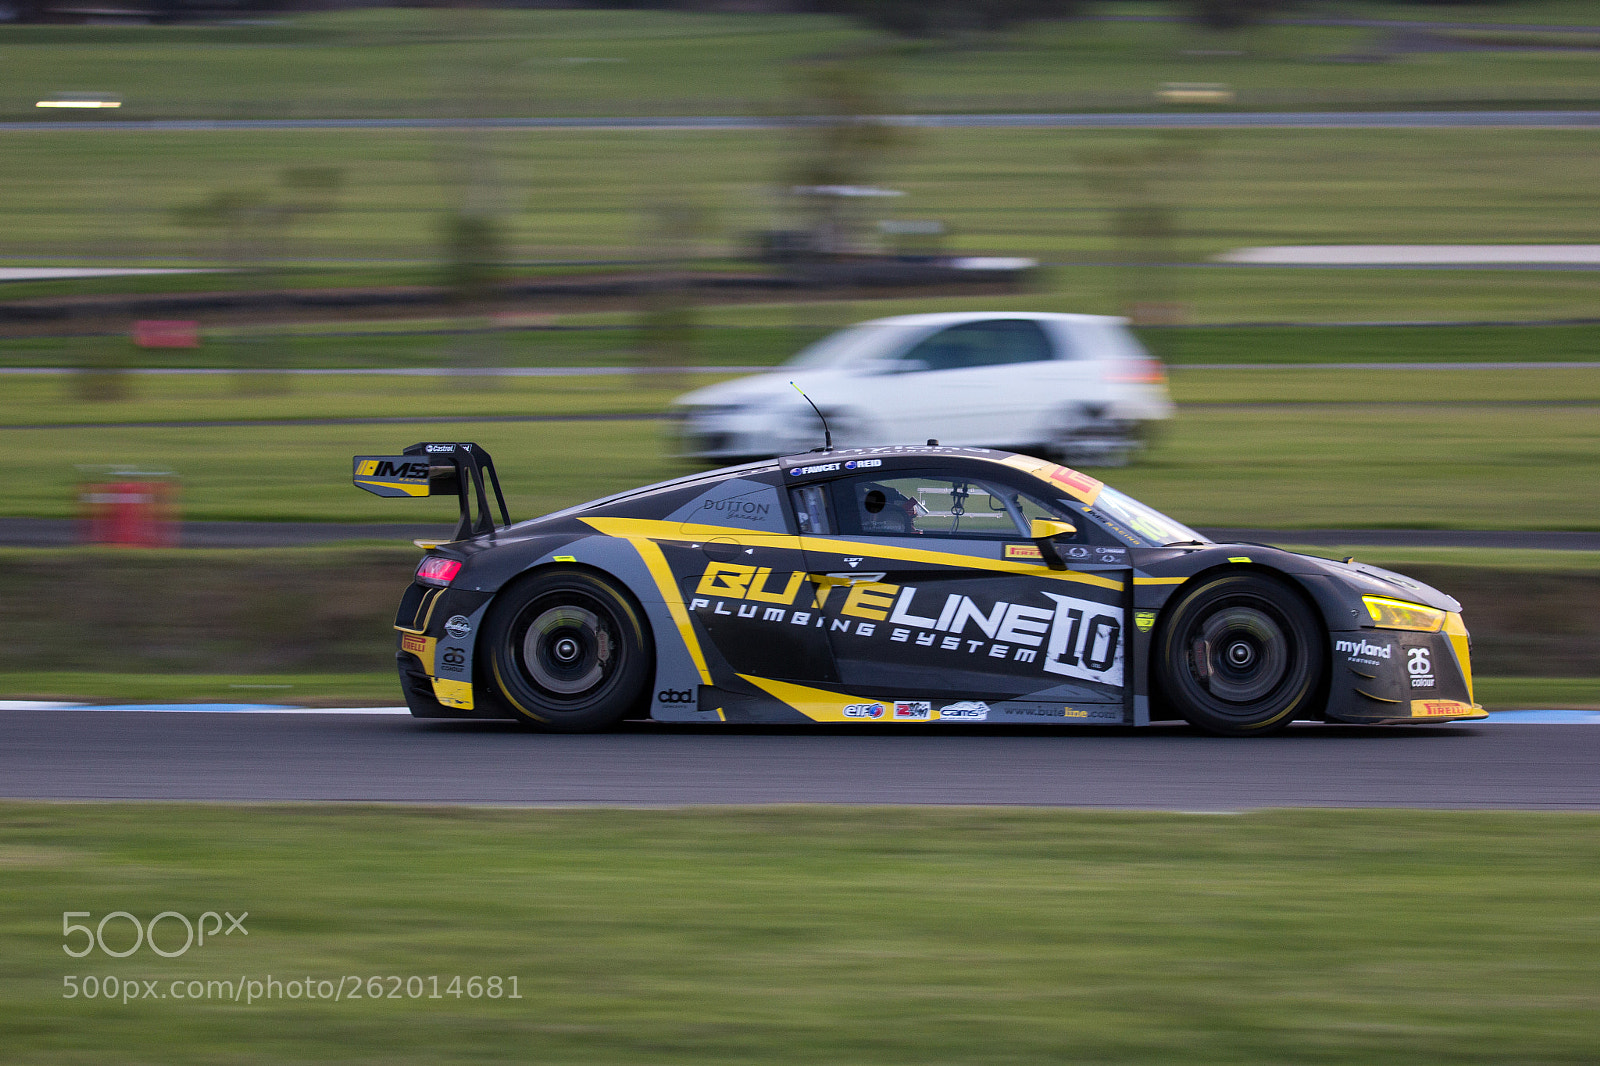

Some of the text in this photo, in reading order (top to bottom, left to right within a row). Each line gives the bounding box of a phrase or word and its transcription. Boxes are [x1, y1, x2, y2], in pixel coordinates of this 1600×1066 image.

[432, 444, 454, 452] Castrol
[373, 460, 430, 479] IMS
[802, 462, 841, 474] FAWCET
[857, 459, 882, 468] REID
[703, 499, 770, 515] DUTTON
[695, 561, 1055, 646] BUTELINE
[689, 598, 1038, 663] PLUMBING SYSTEM
[403, 634, 426, 652] PIRELLI
[1056, 607, 1121, 672] 10
[1336, 639, 1391, 659] myland
[1411, 678, 1436, 687] colour
[1004, 706, 1116, 719] www.buteline.com
[1424, 702, 1465, 715] PIRELLI
